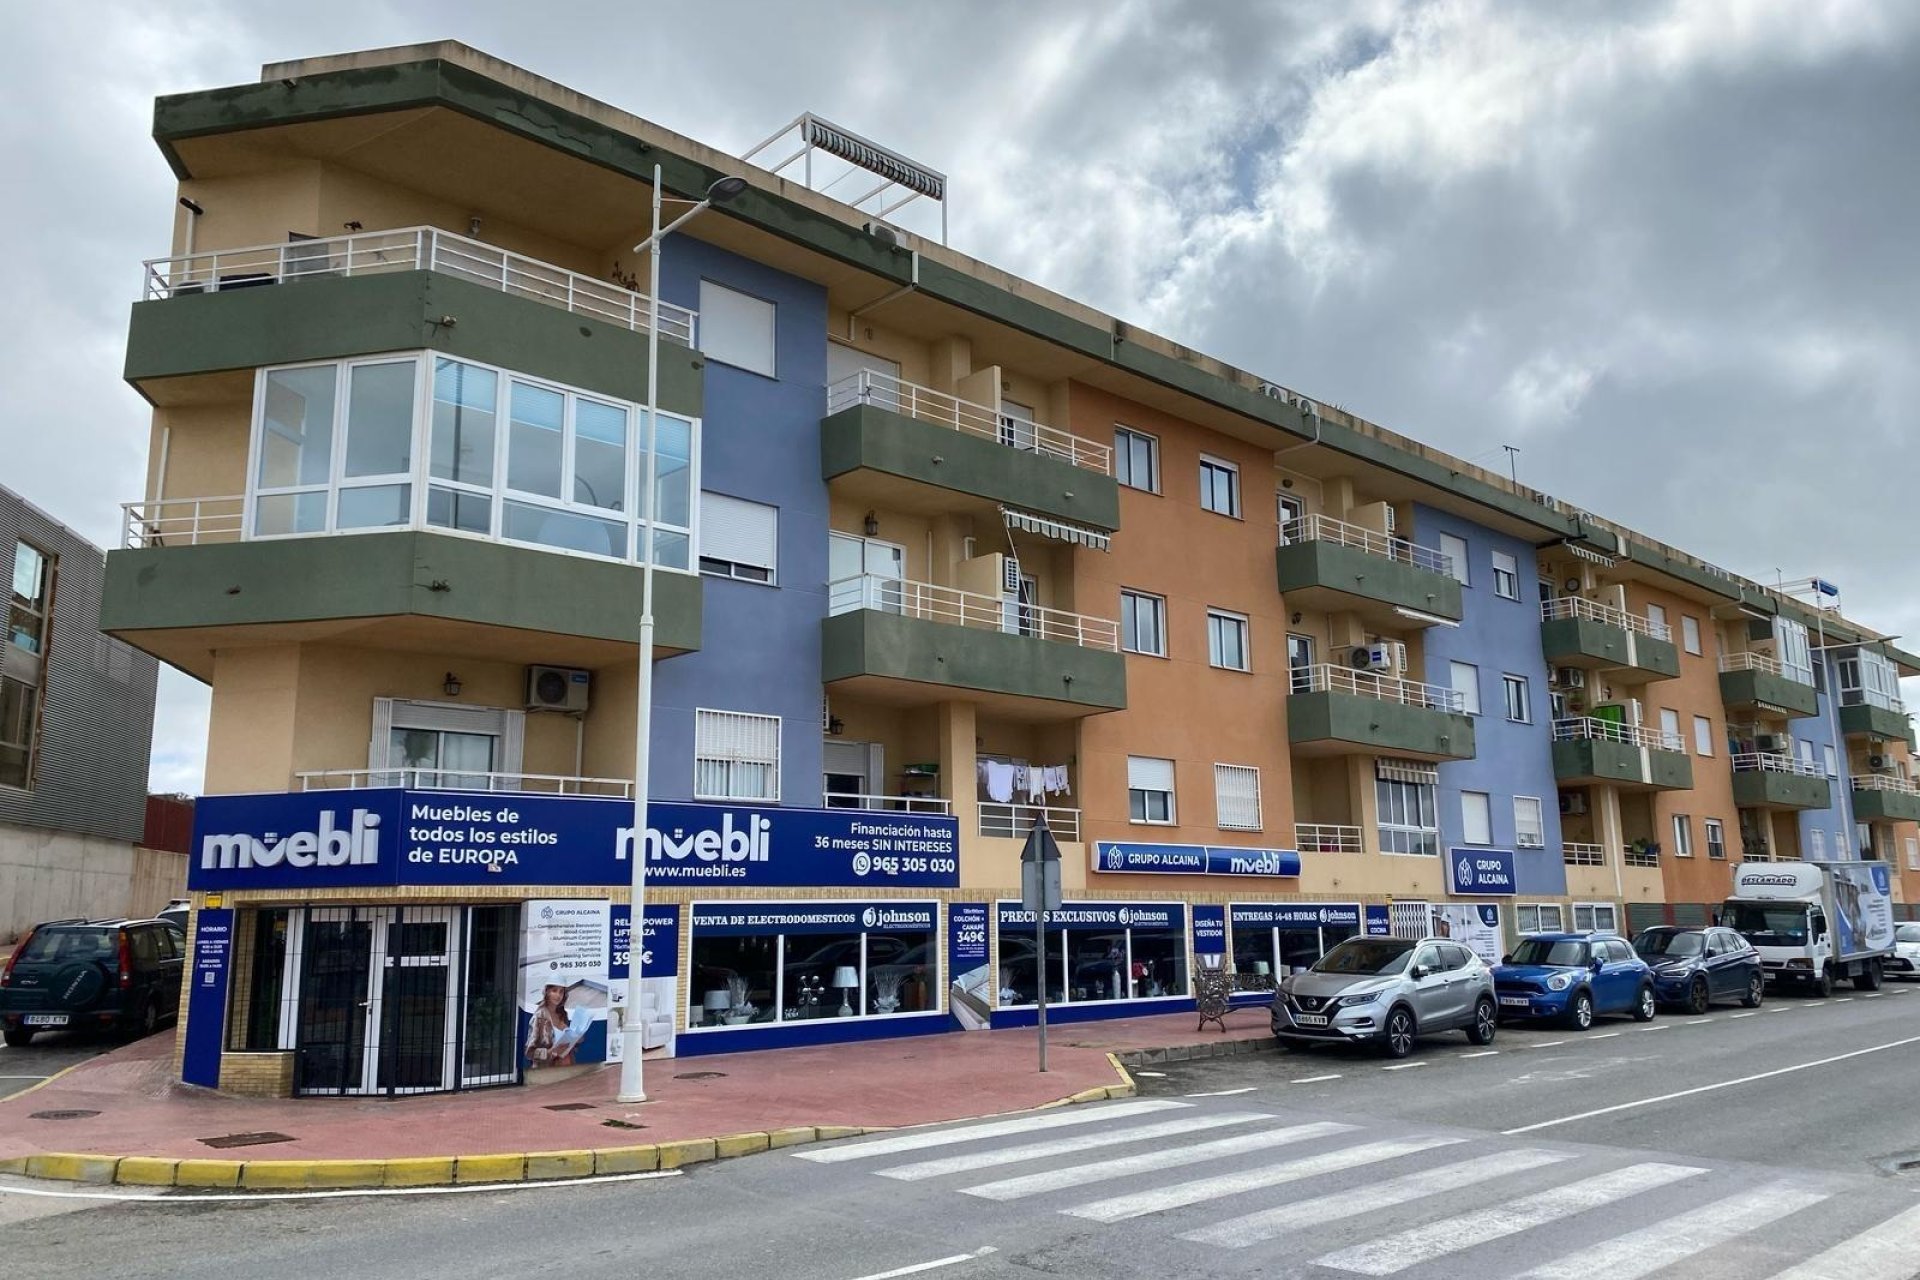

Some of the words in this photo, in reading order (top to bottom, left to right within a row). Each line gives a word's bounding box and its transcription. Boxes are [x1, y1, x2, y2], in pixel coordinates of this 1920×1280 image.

[411, 804, 492, 822] Muebles
[496, 808, 519, 823] de
[409, 826, 464, 842] todos
[469, 827, 496, 843] los
[500, 828, 558, 844] estilos
[615, 813, 771, 861] muebli
[851, 822, 921, 838] Financiación
[923, 826, 952, 838] hasta
[201, 808, 381, 869] muebli
[815, 836, 829, 848] 36
[832, 838, 870, 850] meses
[872, 839, 891, 851] SIN
[894, 841, 952, 853] INTERESES
[408, 847, 433, 863] de
[439, 848, 518, 864] EUROPA
[1128, 853, 1159, 864] GRUPO
[1161, 854, 1200, 866] ALCAINA
[872, 856, 899, 871] 965
[902, 857, 927, 872] 305
[930, 858, 955, 873] 030
[1231, 852, 1280, 874] muebli
[1476, 860, 1501, 870] GRUPO
[644, 864, 746, 878] www.muebli.es
[1478, 873, 1509, 885] ALCAINA
[555, 908, 575, 916] GRUPO
[877, 910, 931, 926] johnson
[1000, 911, 1050, 922] PRECIS
[1052, 910, 1116, 922] EXCLUSIVOS
[1129, 909, 1168, 923] johnson
[1233, 911, 1273, 921] ENTREGAS
[1294, 911, 1317, 921] HORAS
[1327, 909, 1356, 921] johnson
[614, 918, 632, 926] REL
[643, 918, 673, 926] POWER
[693, 916, 728, 925] VENTA
[730, 915, 745, 925] DE
[747, 914, 856, 924] ELECTRODOMESTICOS
[1195, 918, 1215, 927] DISEÑA
[957, 931, 985, 943] 349€
[1196, 929, 1223, 937] VESTIDOR
[613, 951, 653, 965] 39€
